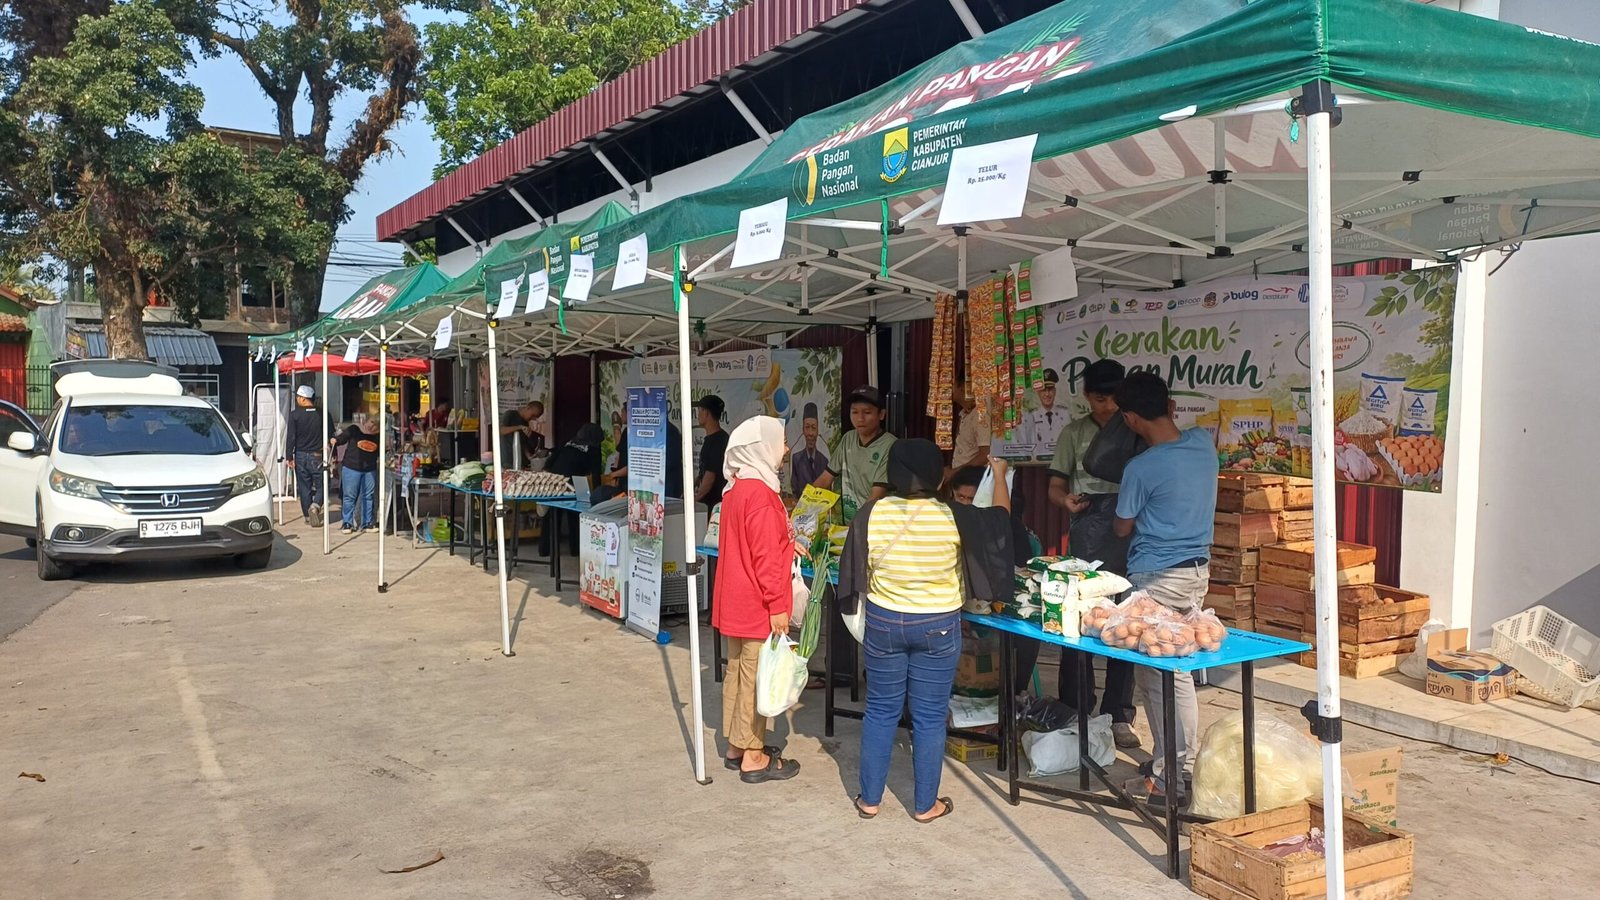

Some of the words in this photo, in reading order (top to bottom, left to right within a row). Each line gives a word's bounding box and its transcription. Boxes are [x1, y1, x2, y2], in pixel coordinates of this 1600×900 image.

[914, 40, 1077, 102] PANGAN
[913, 118, 968, 143] PEMERINTAH
[913, 134, 963, 157] KABUPATEN
[822, 149, 850, 166] Badan
[911, 152, 950, 172] CIANJUR
[821, 163, 853, 182] Pangan
[978, 164, 998, 174] TELUR
[821, 177, 859, 198] Nasional
[1230, 289, 1259, 301] bulog
[1094, 316, 1225, 358] Gerakan
[1168, 350, 1263, 389] Murah
[1232, 420, 1264, 430] SPHP
[141, 523, 148, 531] B
[154, 522, 177, 531] 1275
[180, 520, 200, 530] BJH
